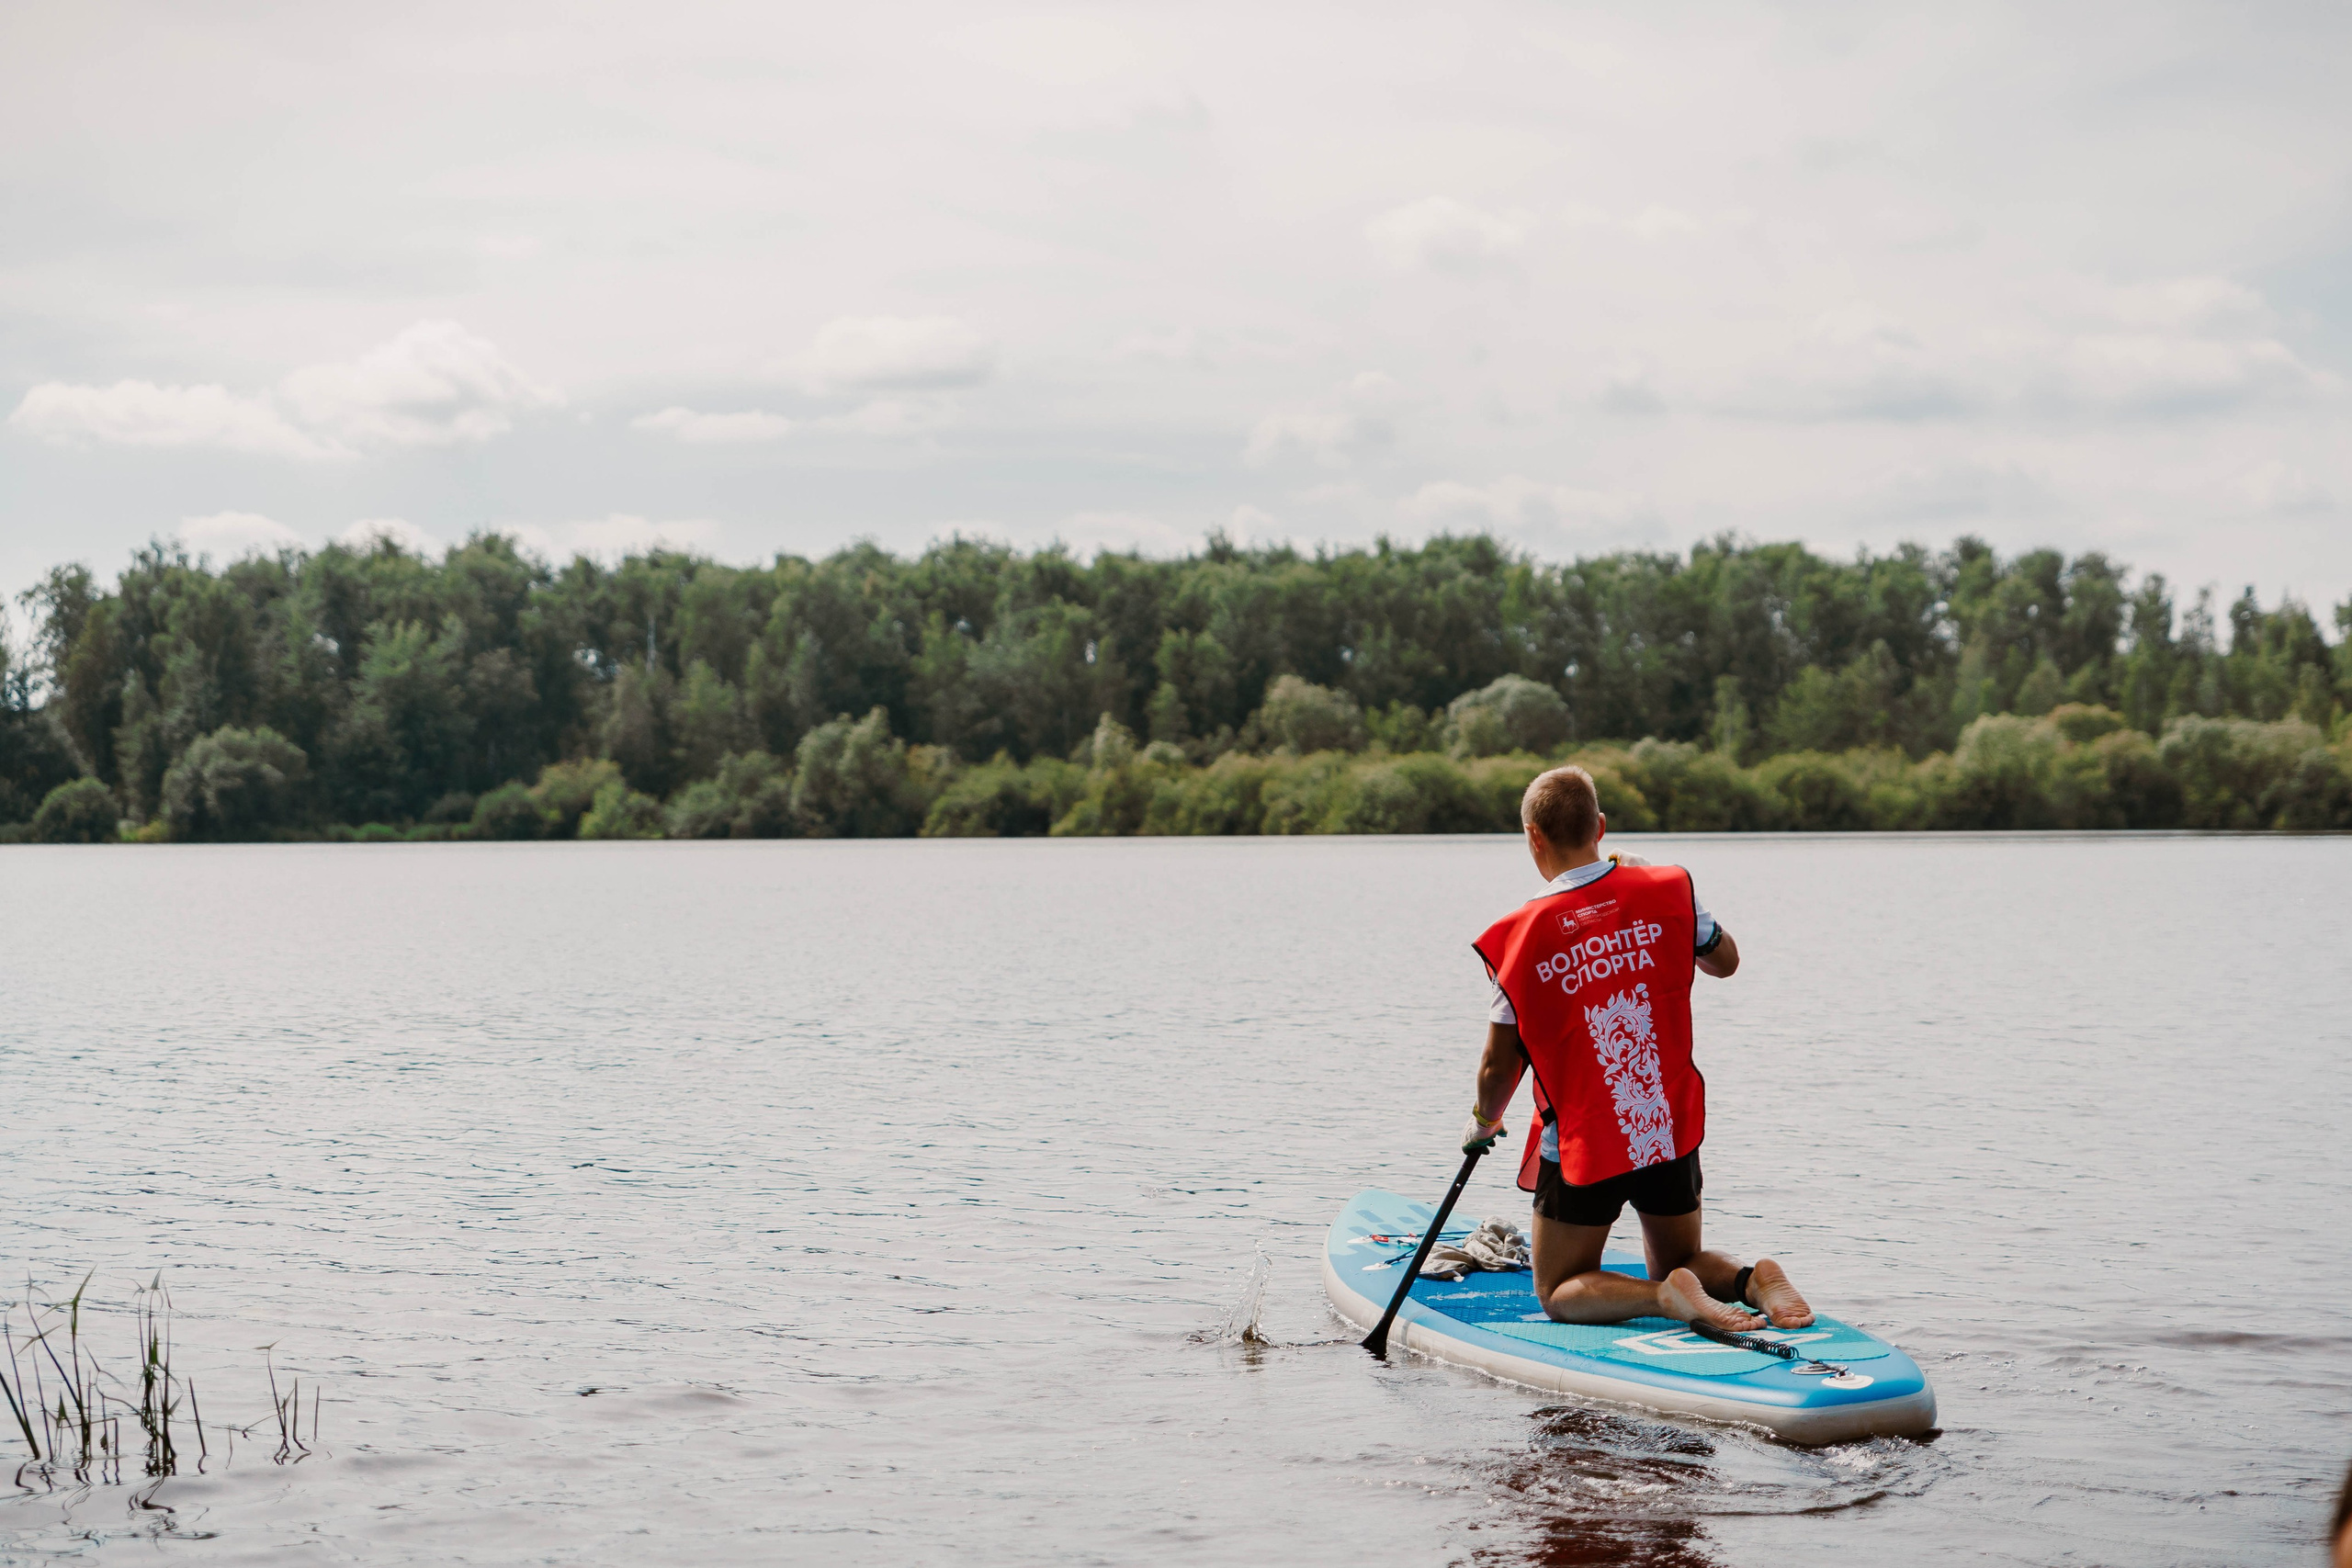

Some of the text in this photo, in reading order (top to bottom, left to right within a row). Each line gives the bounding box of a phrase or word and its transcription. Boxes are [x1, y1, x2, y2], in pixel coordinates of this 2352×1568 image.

[1576, 899, 1617, 914] МИНИСТЕРСТВО
[1577, 909, 1598, 919] СПОРТА
[1535, 919, 1662, 983] ВОЛОНТЁР
[1561, 949, 1656, 995] СПОРТА
